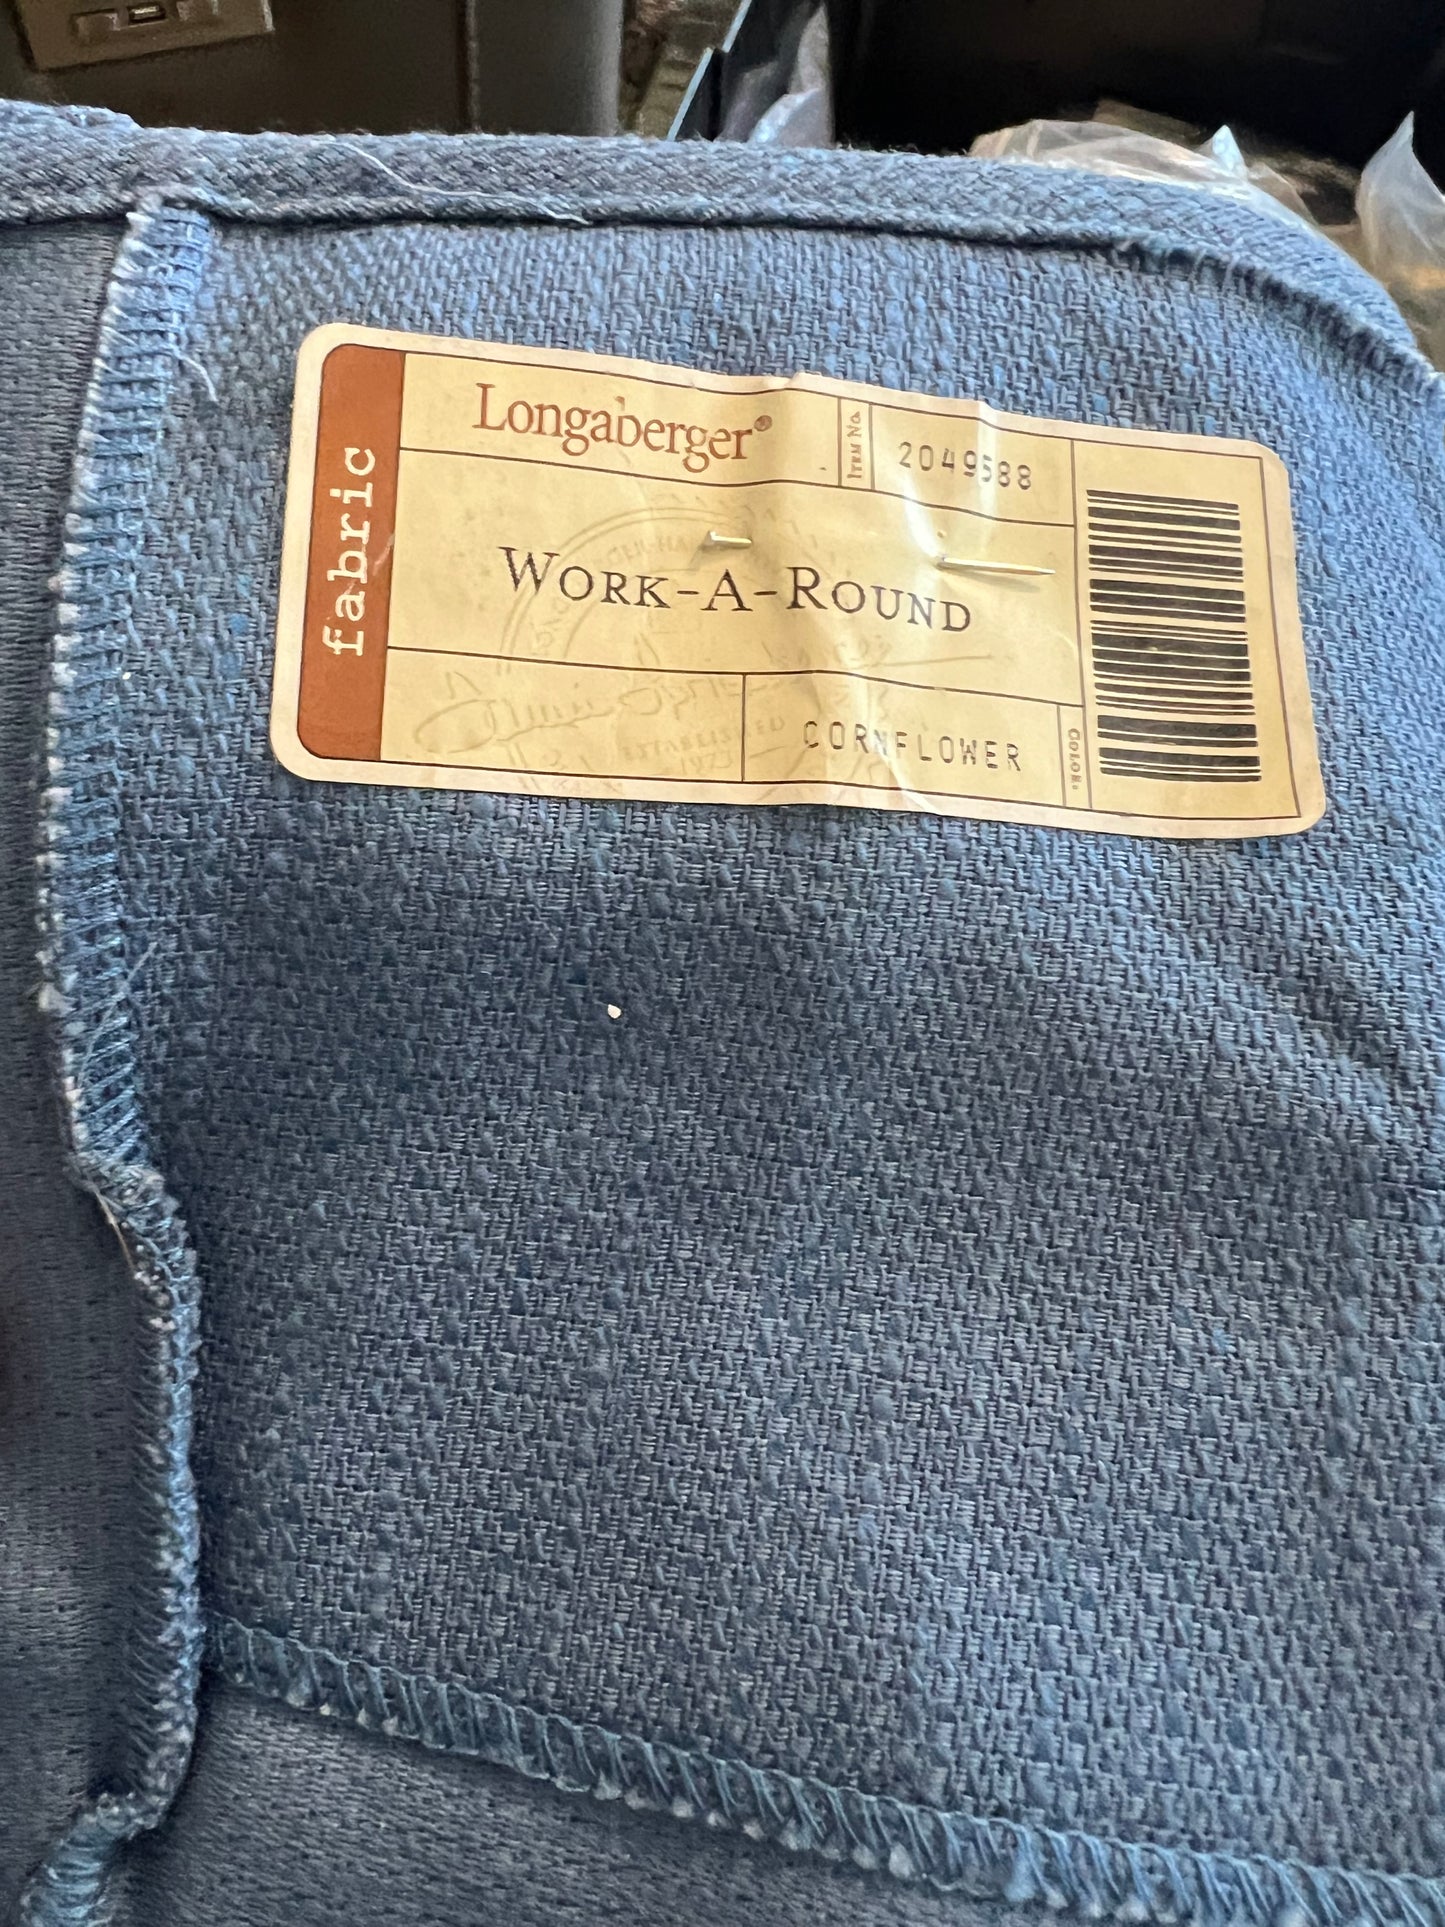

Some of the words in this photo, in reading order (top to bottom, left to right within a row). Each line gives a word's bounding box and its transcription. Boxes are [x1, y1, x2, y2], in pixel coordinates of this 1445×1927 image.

[898, 441, 1032, 490] 2049588
[321, 446, 376, 656] fabric
[802, 720, 1022, 772] CORNFLOWER
